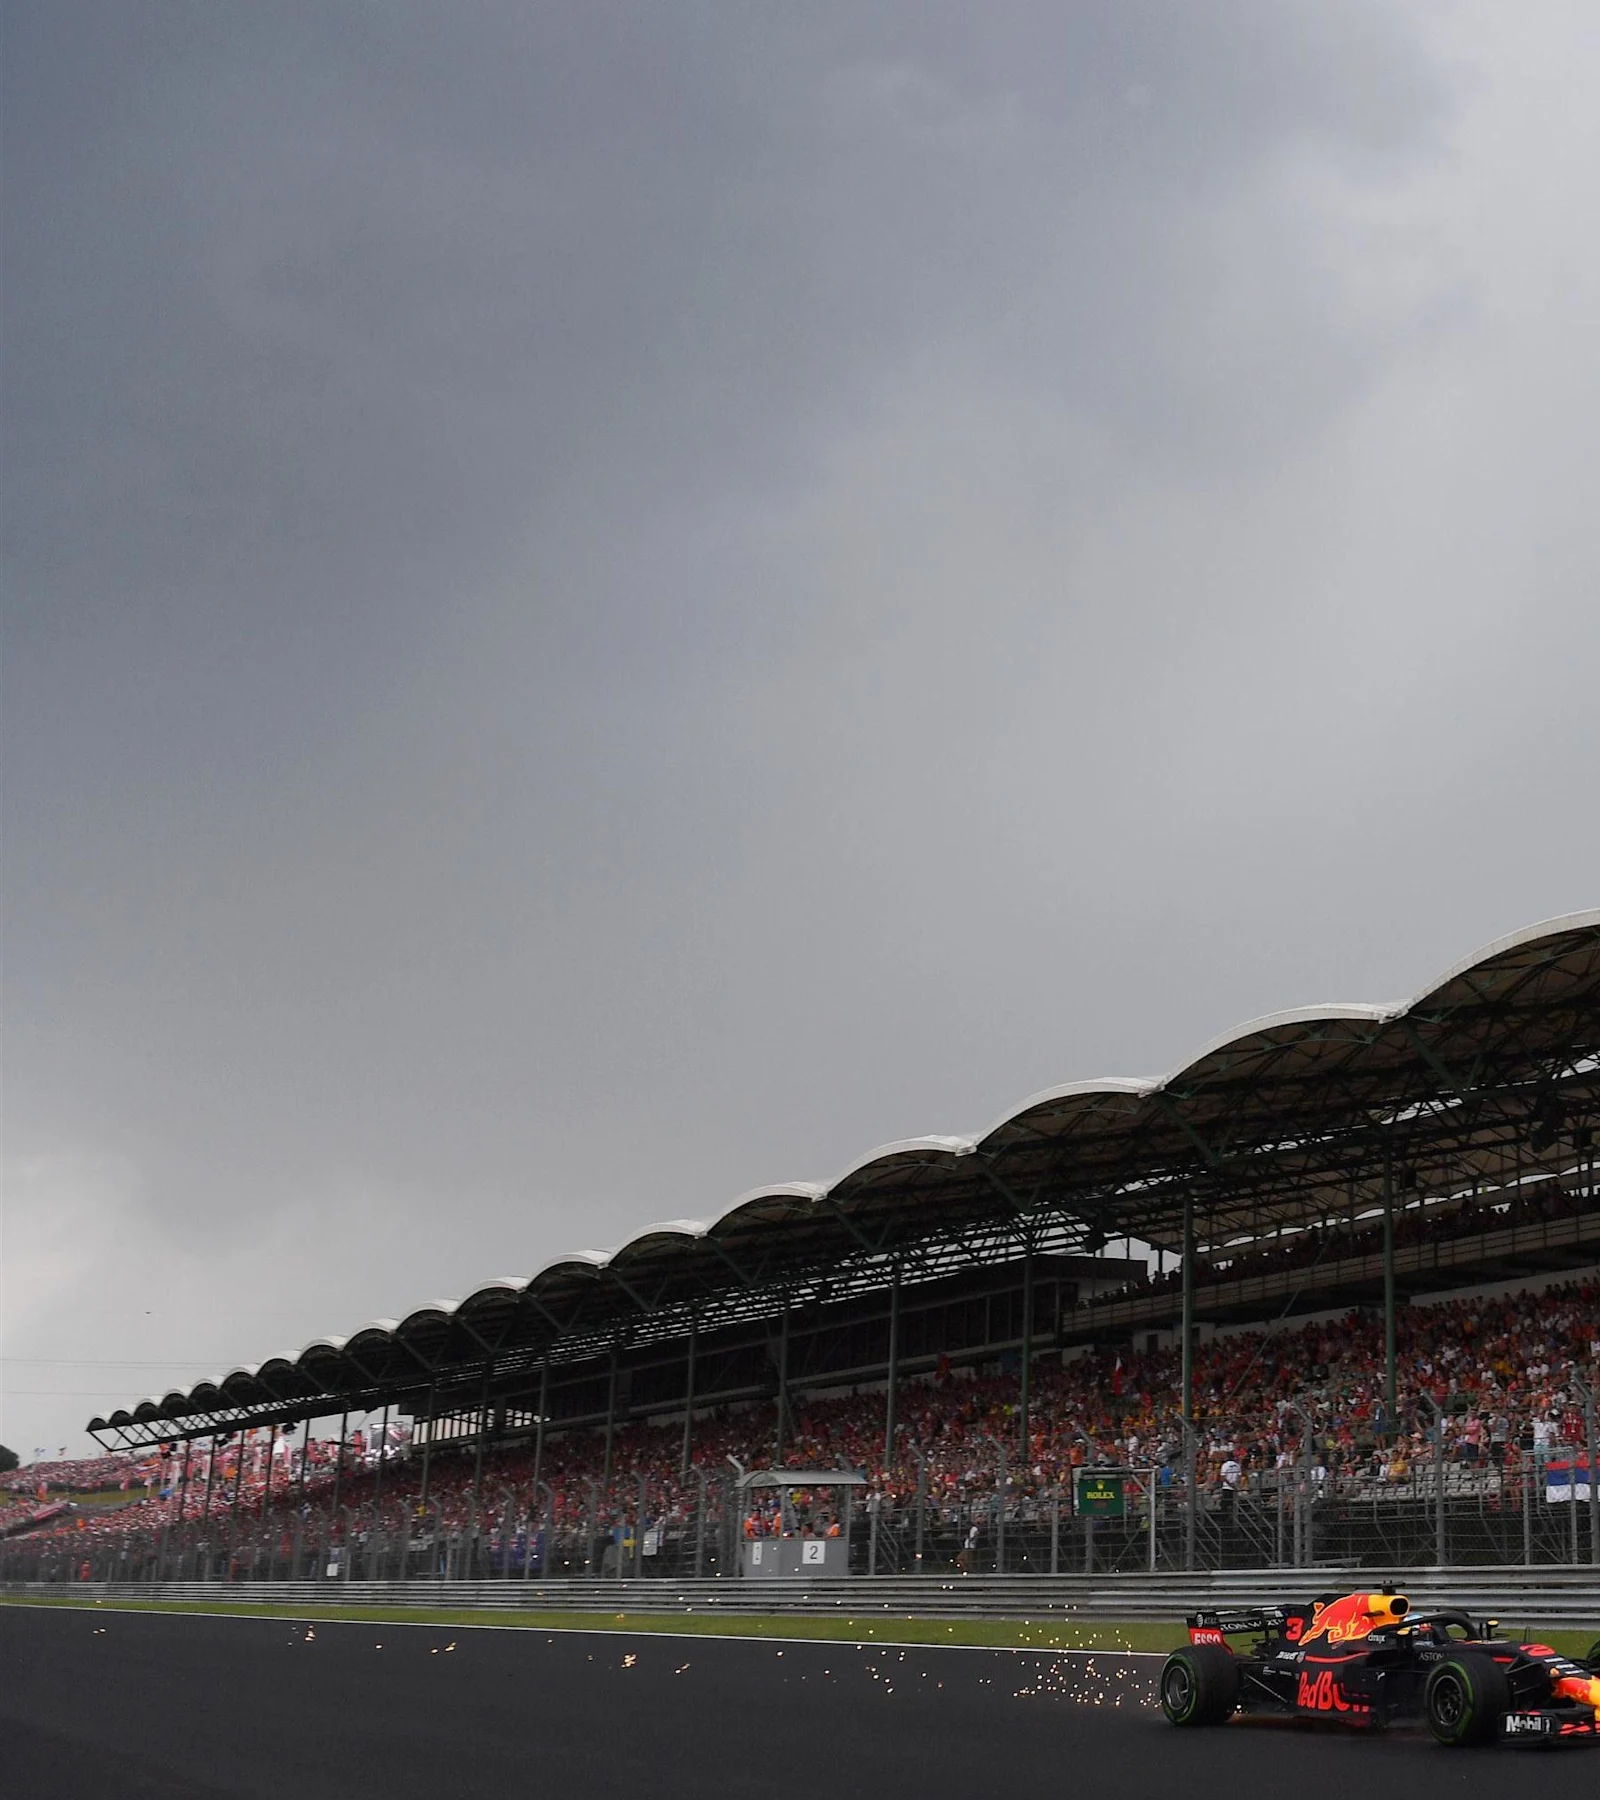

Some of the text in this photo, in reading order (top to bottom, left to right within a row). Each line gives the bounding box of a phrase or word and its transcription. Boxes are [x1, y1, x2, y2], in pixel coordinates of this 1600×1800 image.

[1086, 1491, 1115, 1499] ROLEX
[809, 1545, 819, 1560] 2
[1286, 1617, 1304, 1641] 3
[1506, 1715, 1541, 1732] Mobil
